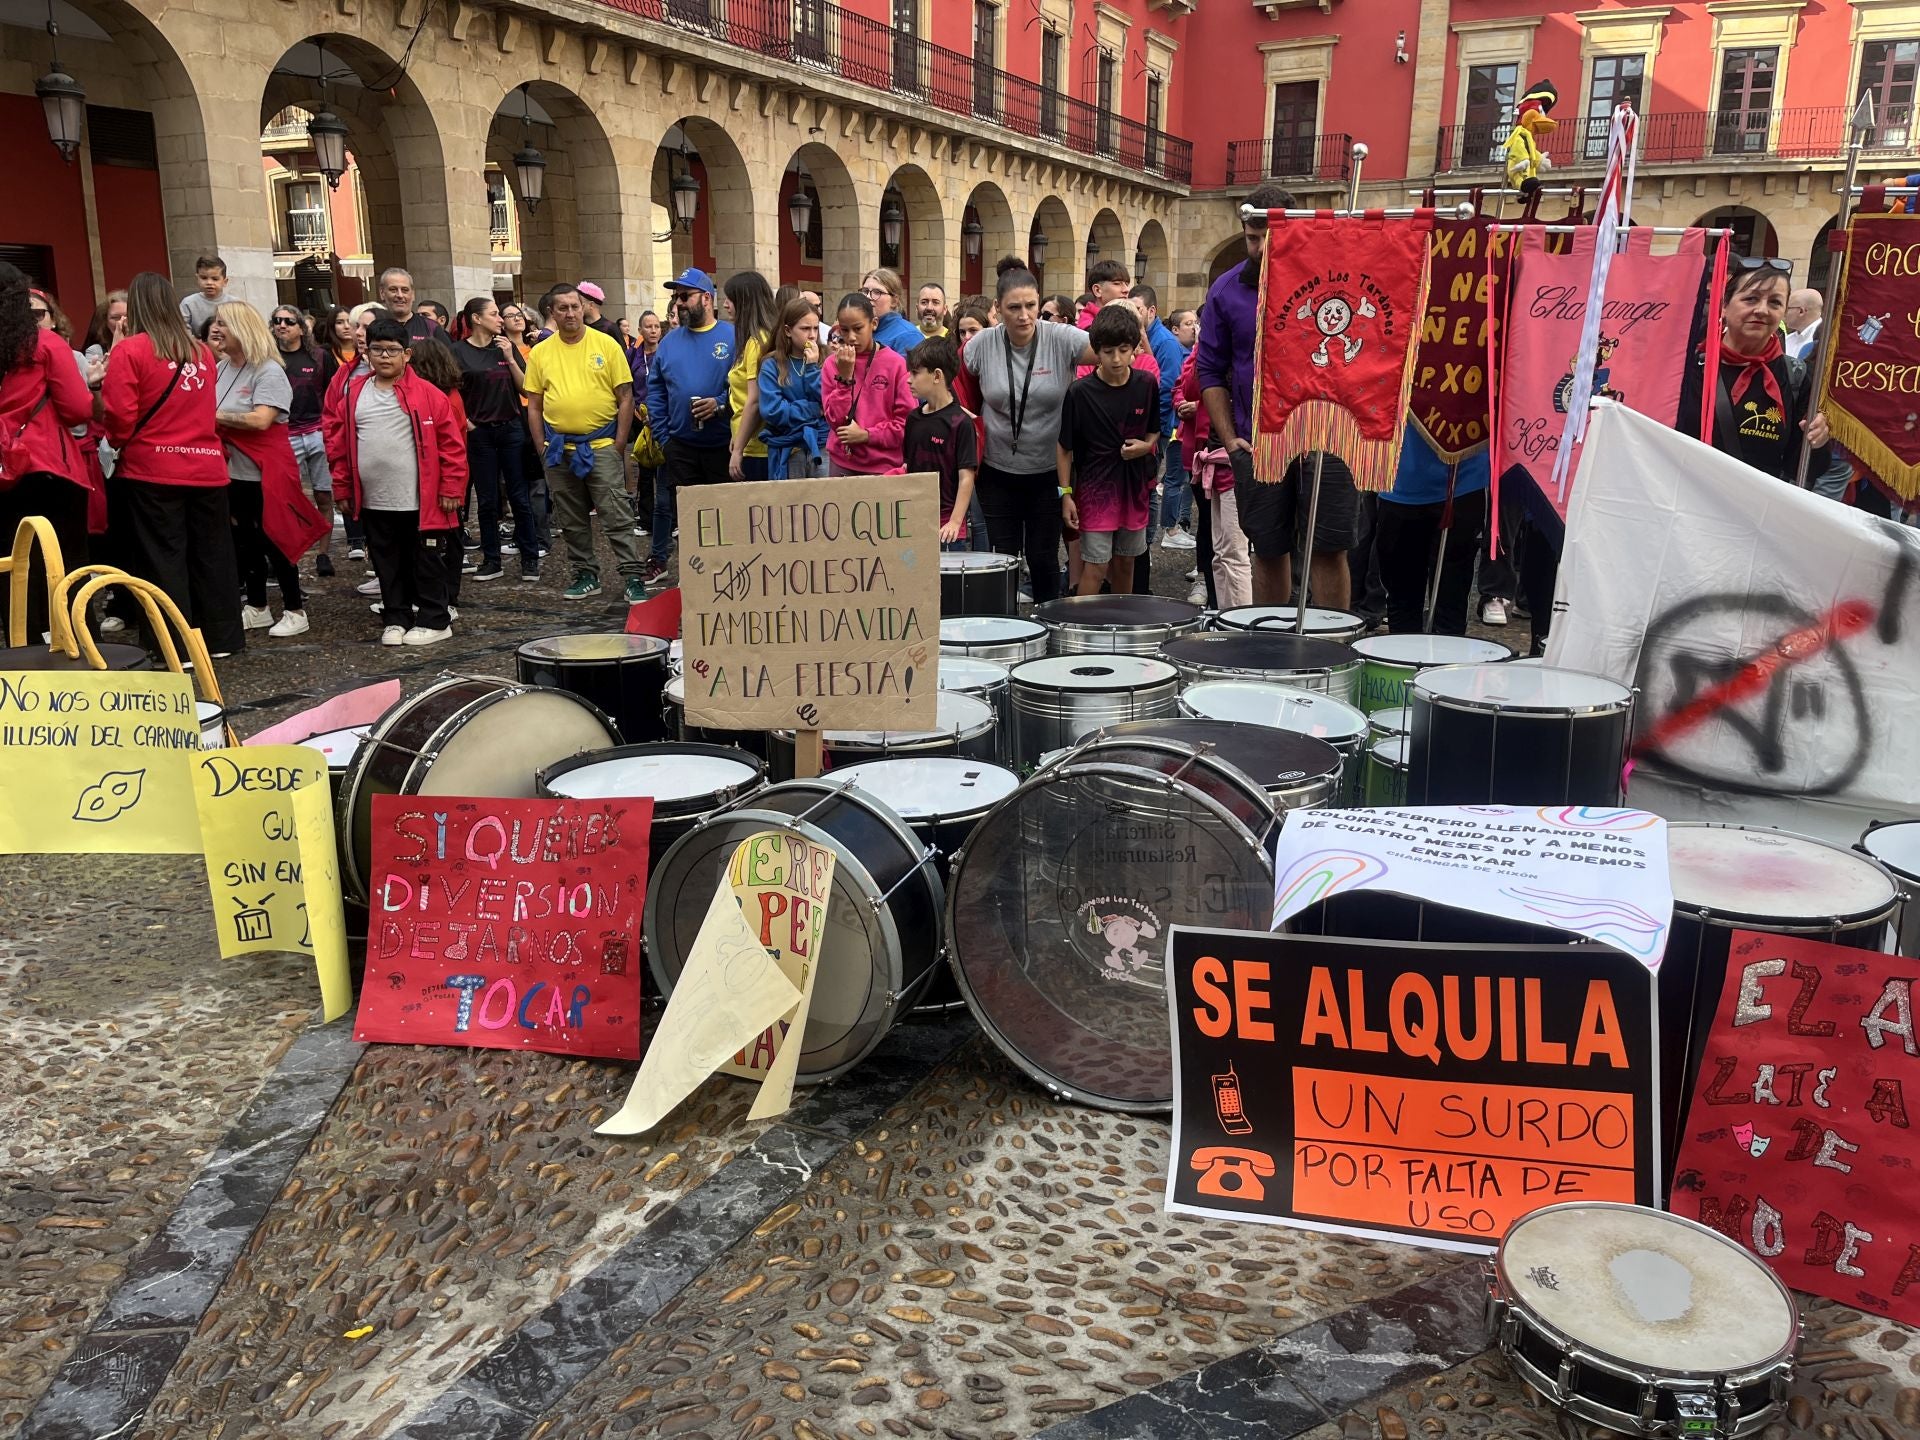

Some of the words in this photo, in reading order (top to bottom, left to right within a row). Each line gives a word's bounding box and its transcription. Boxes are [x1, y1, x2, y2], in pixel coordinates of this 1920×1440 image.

[1274, 275, 1321, 331] Charanga
[1328, 269, 1350, 282] Los
[1530, 285, 1670, 335] Chaanga
[155, 445, 221, 457] #YOSOYTARDON
[697, 507, 734, 547] EL
[749, 501, 841, 545] RUIDO
[851, 499, 913, 547] QUE
[762, 556, 895, 596] MOLESTA,
[697, 604, 809, 647] TAMBIÉN
[820, 608, 854, 642] DA
[856, 606, 924, 641] VIDA
[49, 691, 90, 713] NOS
[174, 692, 190, 714] LA
[708, 665, 731, 697] A
[743, 664, 776, 698] LA
[795, 661, 914, 704] FIESTA!
[91, 724, 123, 748] DEL
[134, 725, 202, 751] CARNAVAL
[394, 811, 448, 862] SI
[1301, 820, 1329, 829] DE
[1334, 823, 1417, 841] CUATRO
[1424, 838, 1495, 853] MESES
[1502, 848, 1532, 858] NO
[1540, 851, 1647, 869] PODEMOS
[1307, 810, 1396, 827] COLORES
[1402, 823, 1429, 833] LA
[1437, 829, 1515, 843] CIUDAD
[1523, 838, 1537, 846] Y
[1545, 839, 1561, 848] A
[1570, 841, 1646, 857] MENOS
[1384, 810, 1478, 828] FEBRERO
[1485, 823, 1596, 838] LLENANDO
[1604, 833, 1633, 843] DE
[275, 861, 304, 885] EN
[730, 834, 836, 902] IERE
[1386, 850, 1469, 869] CHARANGAS
[1473, 865, 1492, 873] DE
[1497, 868, 1539, 880] XIXÓN
[1411, 846, 1516, 868] ENSAYAR
[382, 873, 620, 923] DIVERSION
[379, 921, 588, 966] DEJARNOS
[445, 974, 592, 1033] TOCAR
[1192, 956, 1276, 1042] SE
[1300, 966, 1630, 1068] ALQUILA
[1312, 1079, 1405, 1136] UN
[1434, 1094, 1629, 1149] SURDO
[1784, 1116, 1861, 1175] DE
[1295, 1144, 1392, 1190] POR
[1399, 1158, 1503, 1199] FALTA
[1522, 1166, 1591, 1195] DE
[1408, 1201, 1495, 1233] USO
[1804, 1210, 1874, 1278] DE
